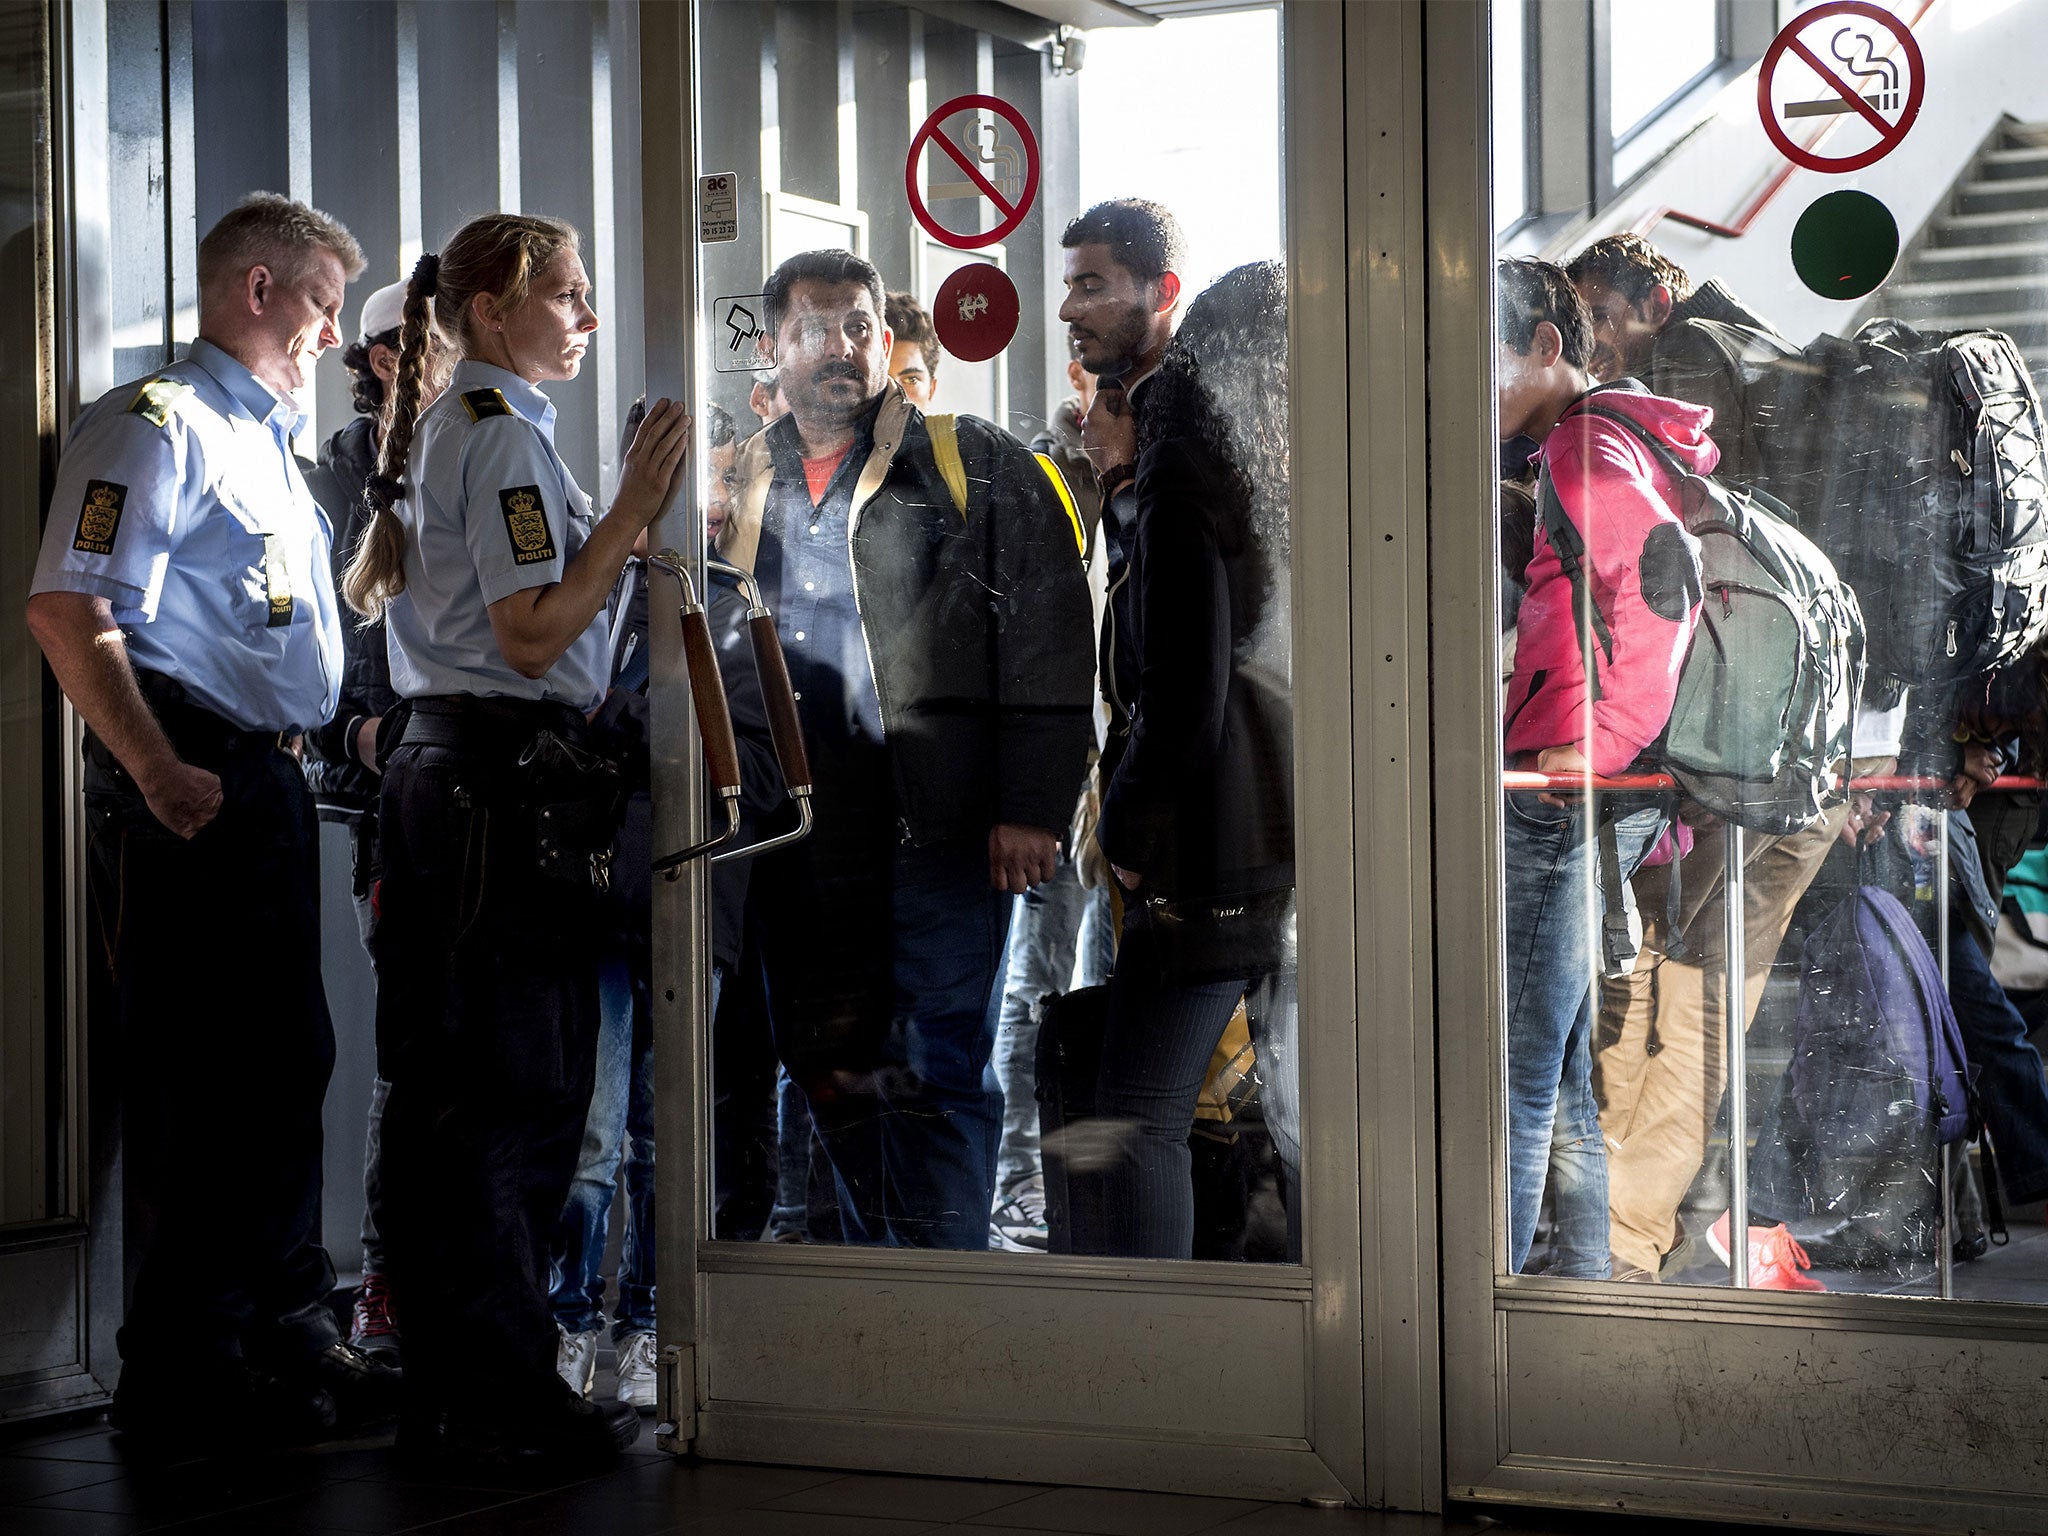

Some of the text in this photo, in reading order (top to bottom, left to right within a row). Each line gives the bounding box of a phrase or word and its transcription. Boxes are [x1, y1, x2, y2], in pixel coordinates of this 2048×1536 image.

[707, 177, 728, 191] ac
[727, 225, 735, 233] 23
[75, 540, 109, 553] POLITI
[517, 549, 553, 562] POLITI
[271, 604, 292, 613] POLITI
